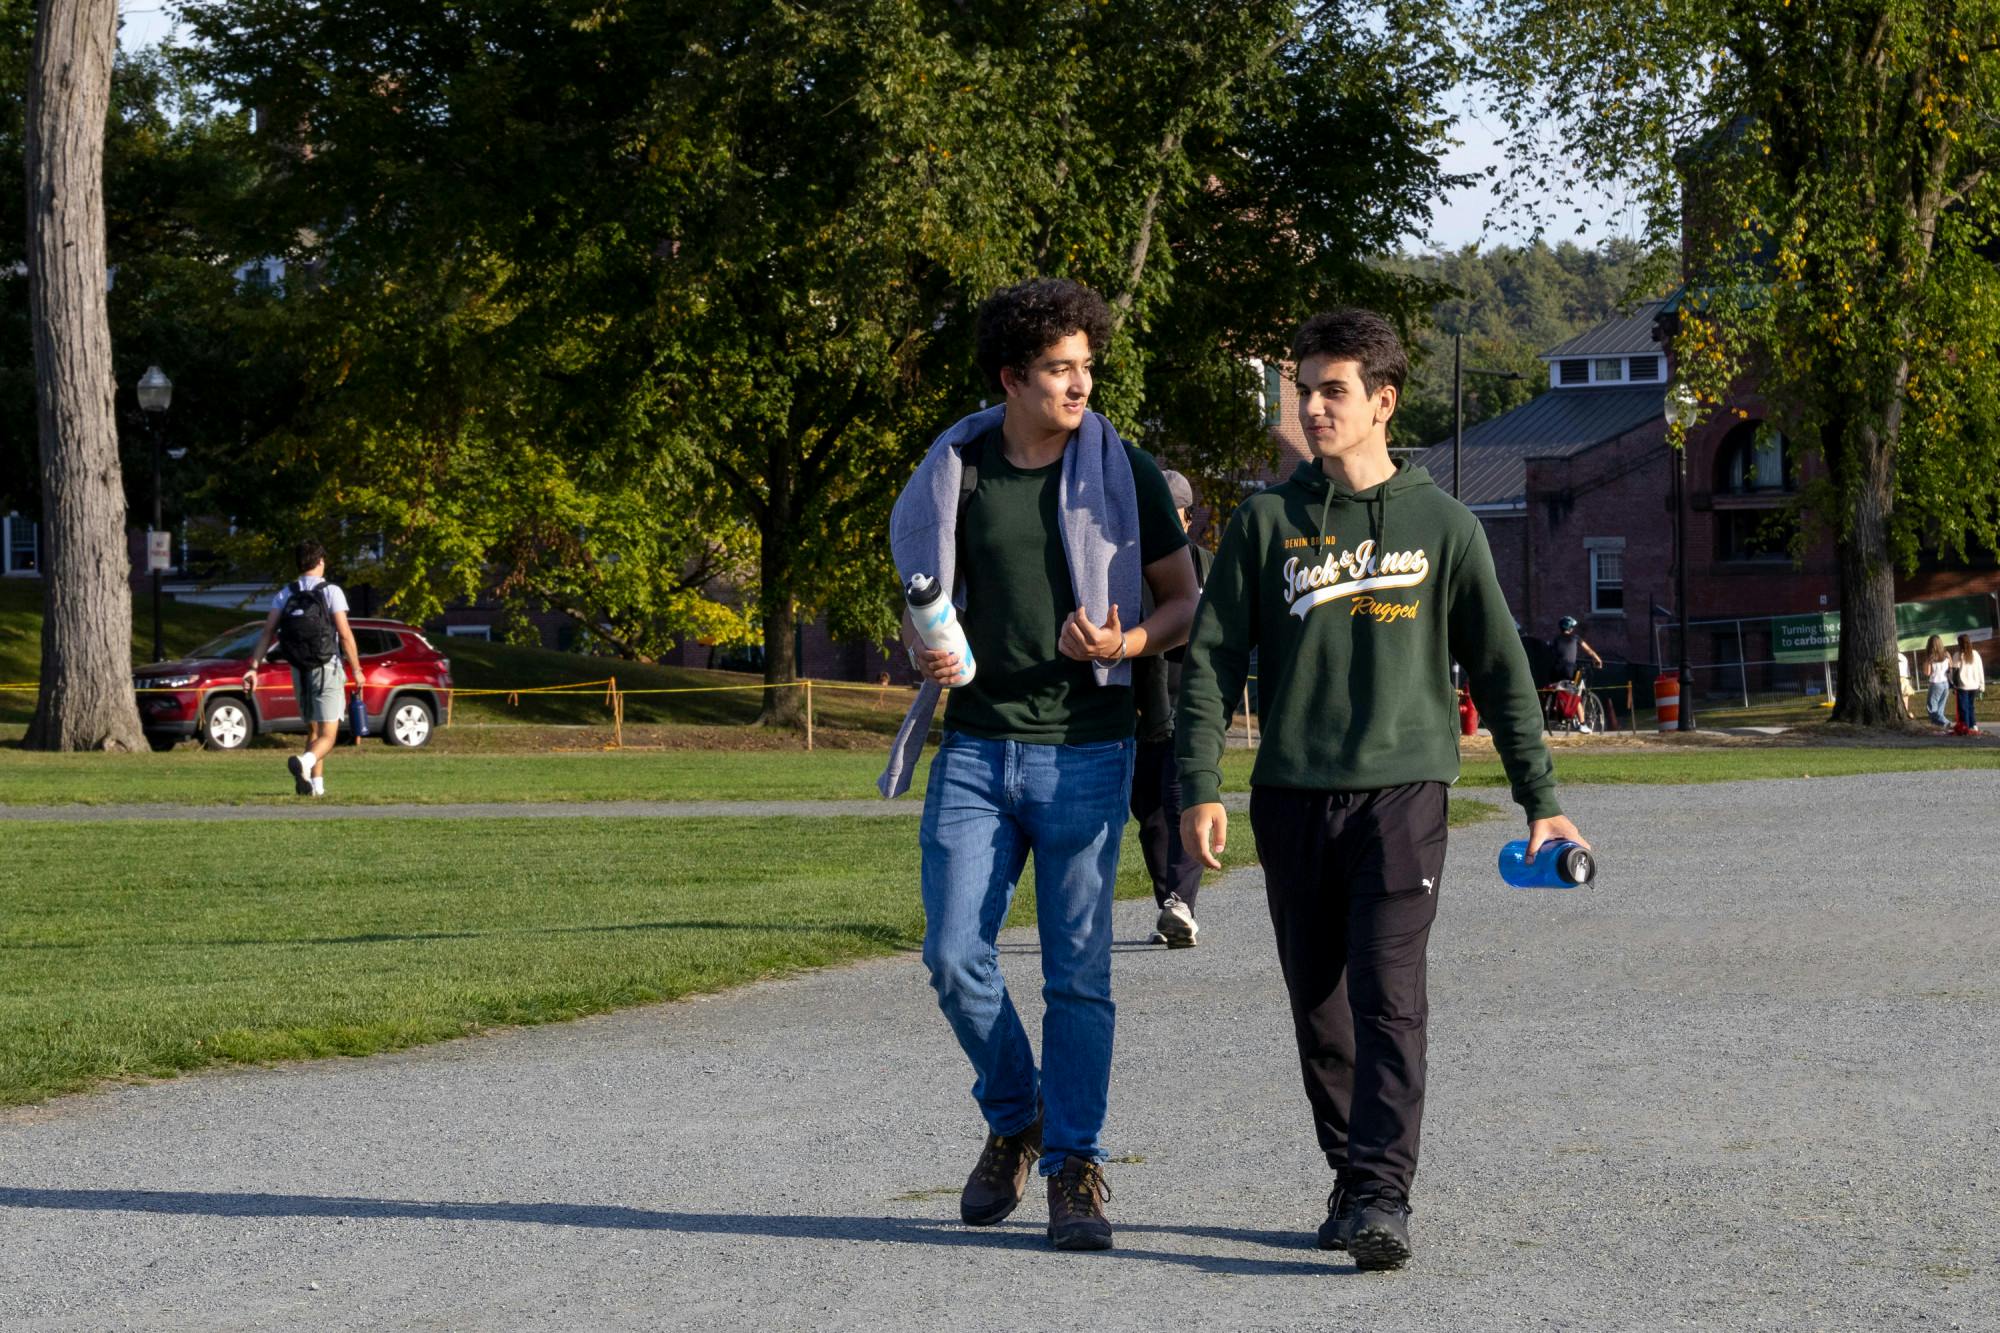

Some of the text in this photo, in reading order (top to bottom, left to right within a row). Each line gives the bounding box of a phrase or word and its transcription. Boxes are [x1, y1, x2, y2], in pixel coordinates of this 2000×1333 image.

[1284, 535, 1336, 549] DENIM BRND
[1283, 556, 1341, 605] Jack
[1350, 595, 1420, 623] Rugged
[1781, 624, 1817, 635] Turning
[1819, 622, 1835, 632] the
[1782, 637, 1793, 647] to
[1794, 634, 1830, 646] carbon
